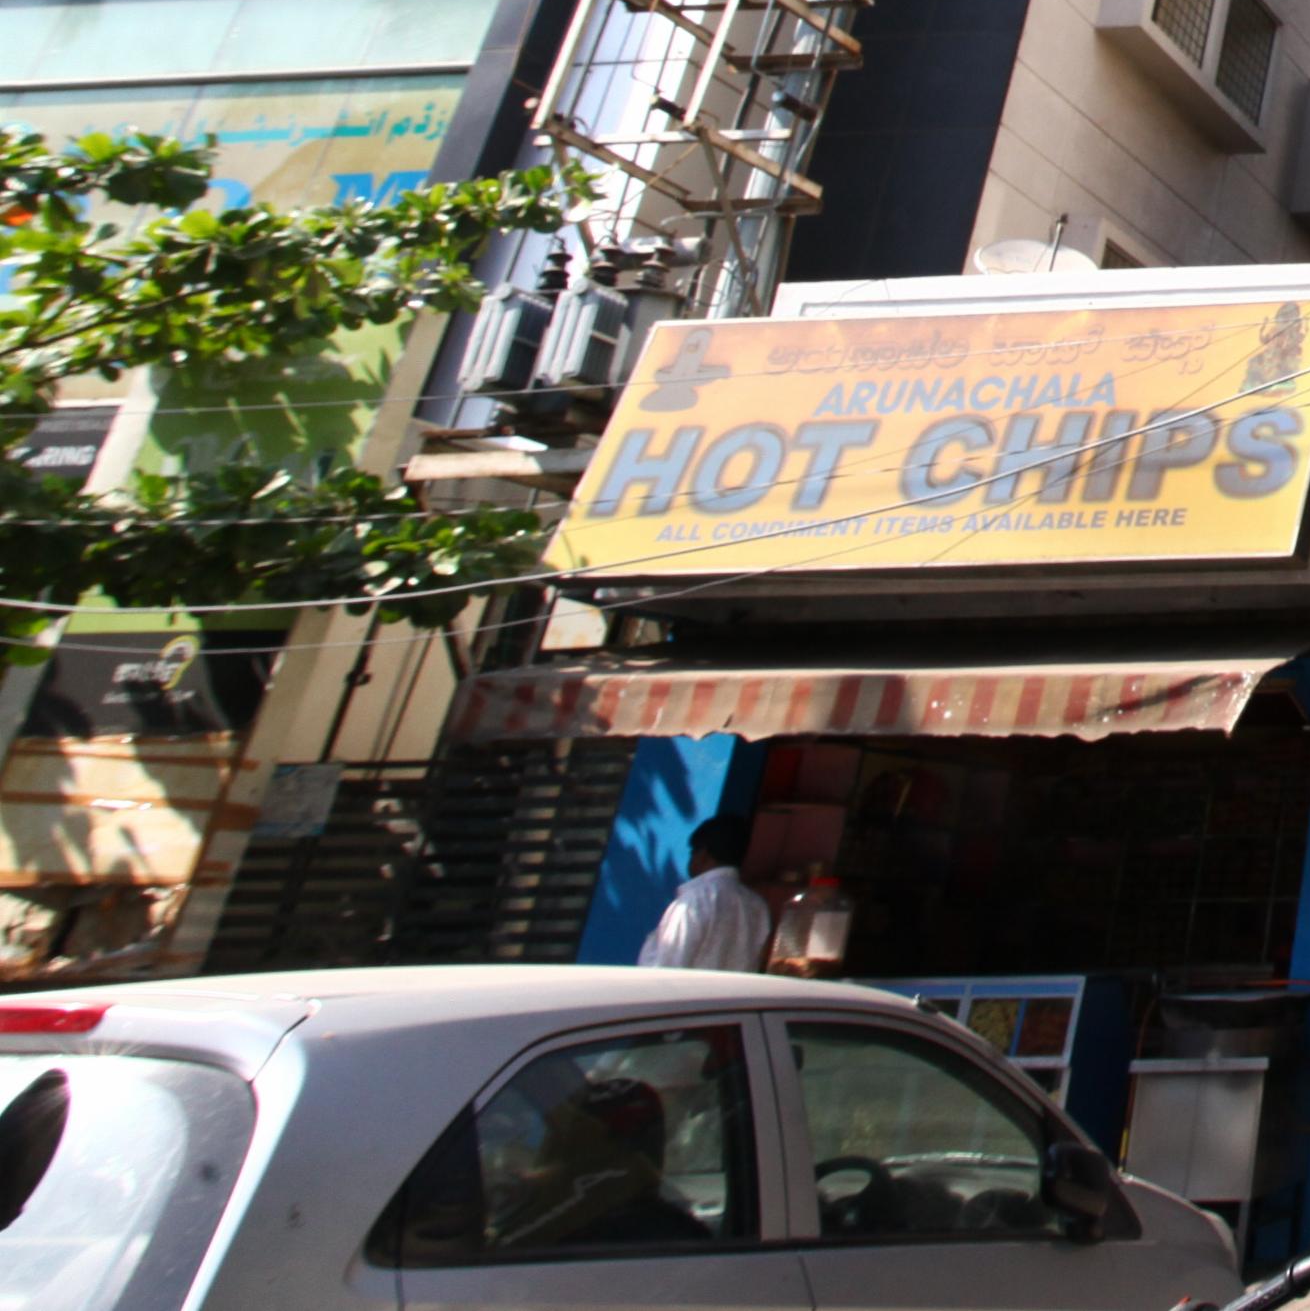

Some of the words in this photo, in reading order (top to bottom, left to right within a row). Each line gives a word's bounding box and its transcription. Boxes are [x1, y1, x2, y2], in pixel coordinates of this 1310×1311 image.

[812, 372, 1117, 417] ARUNACHALA
[587, 418, 878, 519] HOT
[898, 404, 1306, 507] CHIPS
[656, 524, 701, 543] ALL
[873, 512, 956, 536] ITEMS
[961, 510, 1107, 534] AVAILABLE
[1114, 507, 1188, 529] HERE
